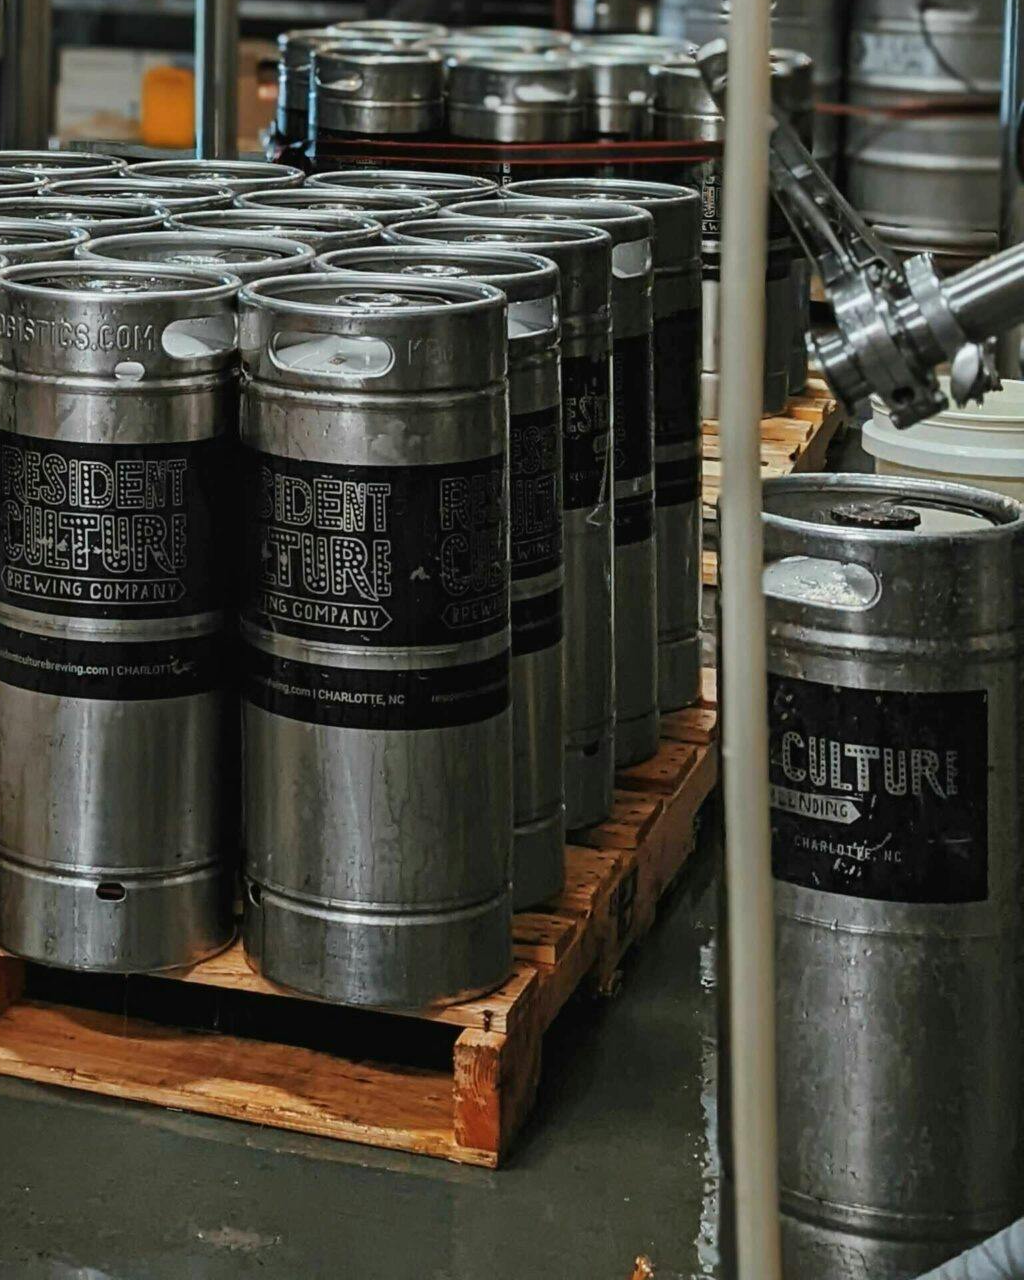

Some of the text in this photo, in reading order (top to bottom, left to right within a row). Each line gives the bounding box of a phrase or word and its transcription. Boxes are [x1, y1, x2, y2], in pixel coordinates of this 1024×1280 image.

[1, 444, 187, 510] RESIDENT
[1, 499, 187, 574] CULTURE
[5, 568, 178, 601] BREWING COMPANY
[292, 602, 380, 627] COMPANY
[318, 689, 387, 706] CHARLOTTE,
[388, 693, 406, 705] NC
[782, 731, 959, 799] CULTURE
[884, 849, 902, 863] NC
